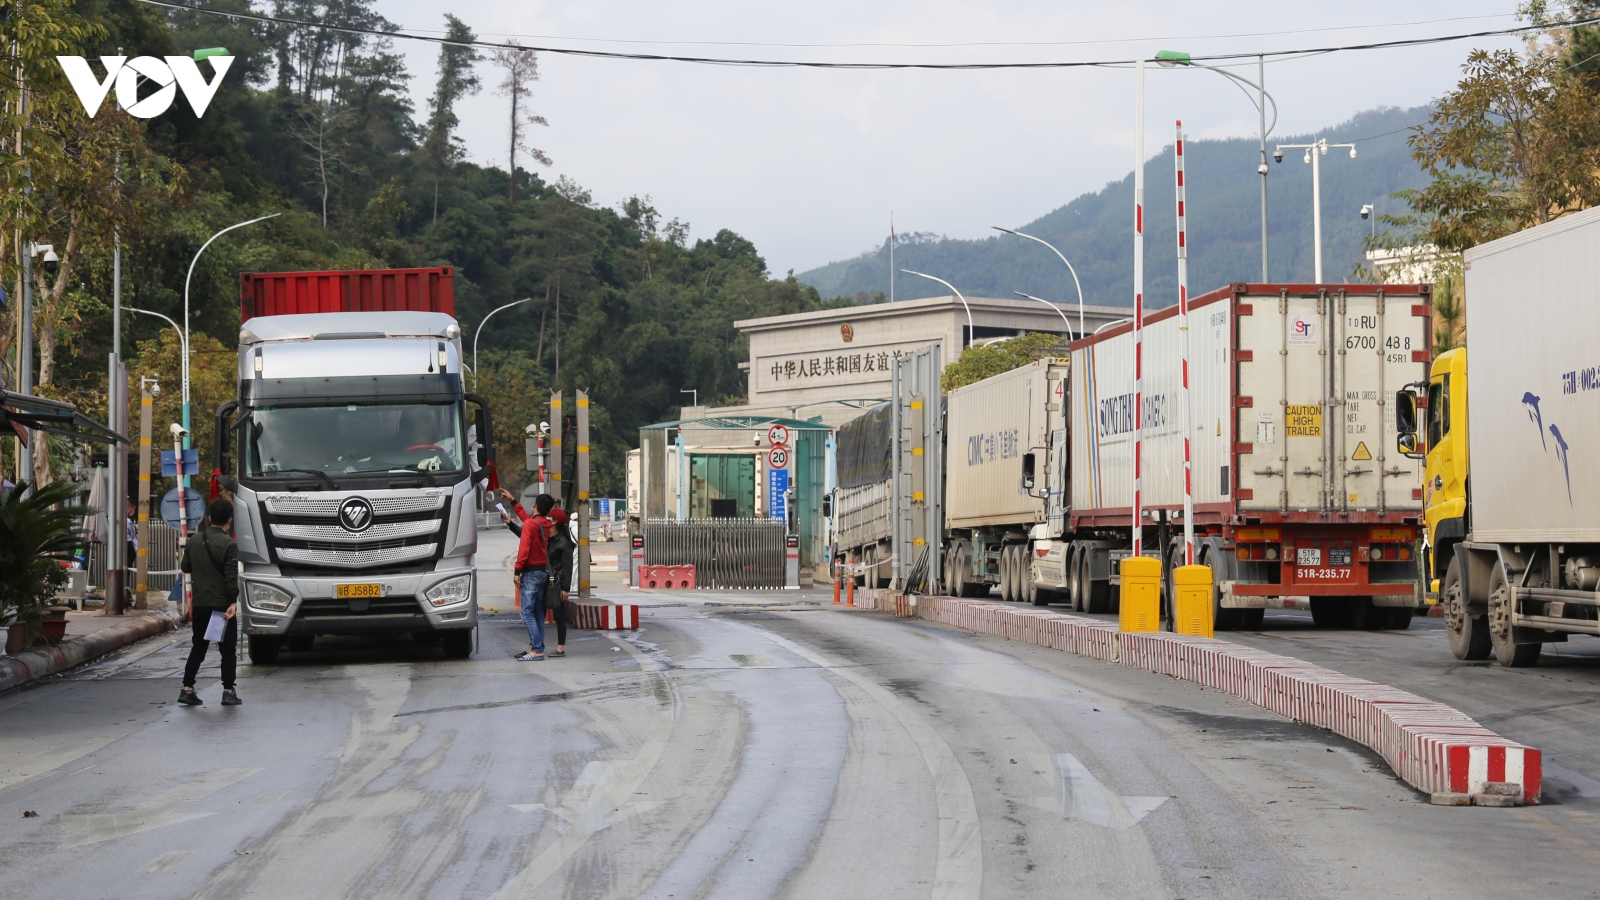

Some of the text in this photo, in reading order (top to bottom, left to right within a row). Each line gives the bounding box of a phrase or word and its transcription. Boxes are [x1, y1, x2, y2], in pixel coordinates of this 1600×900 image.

[1346, 336, 1376, 349] 6700
[1386, 354, 1407, 363] 45R1
[771, 350, 914, 381] 中华人民共和国友谊关
[1346, 391, 1377, 400] MAX GROSS
[1285, 406, 1322, 416] CAUTION
[1347, 402, 1360, 411] TARE
[1293, 416, 1314, 426] HIGH
[1347, 413, 1357, 422] NET
[1286, 426, 1320, 436] TRAILER
[772, 452, 785, 463] 20
[1302, 549, 1316, 557] 51R
[1297, 568, 1351, 579] 51R-235.77
